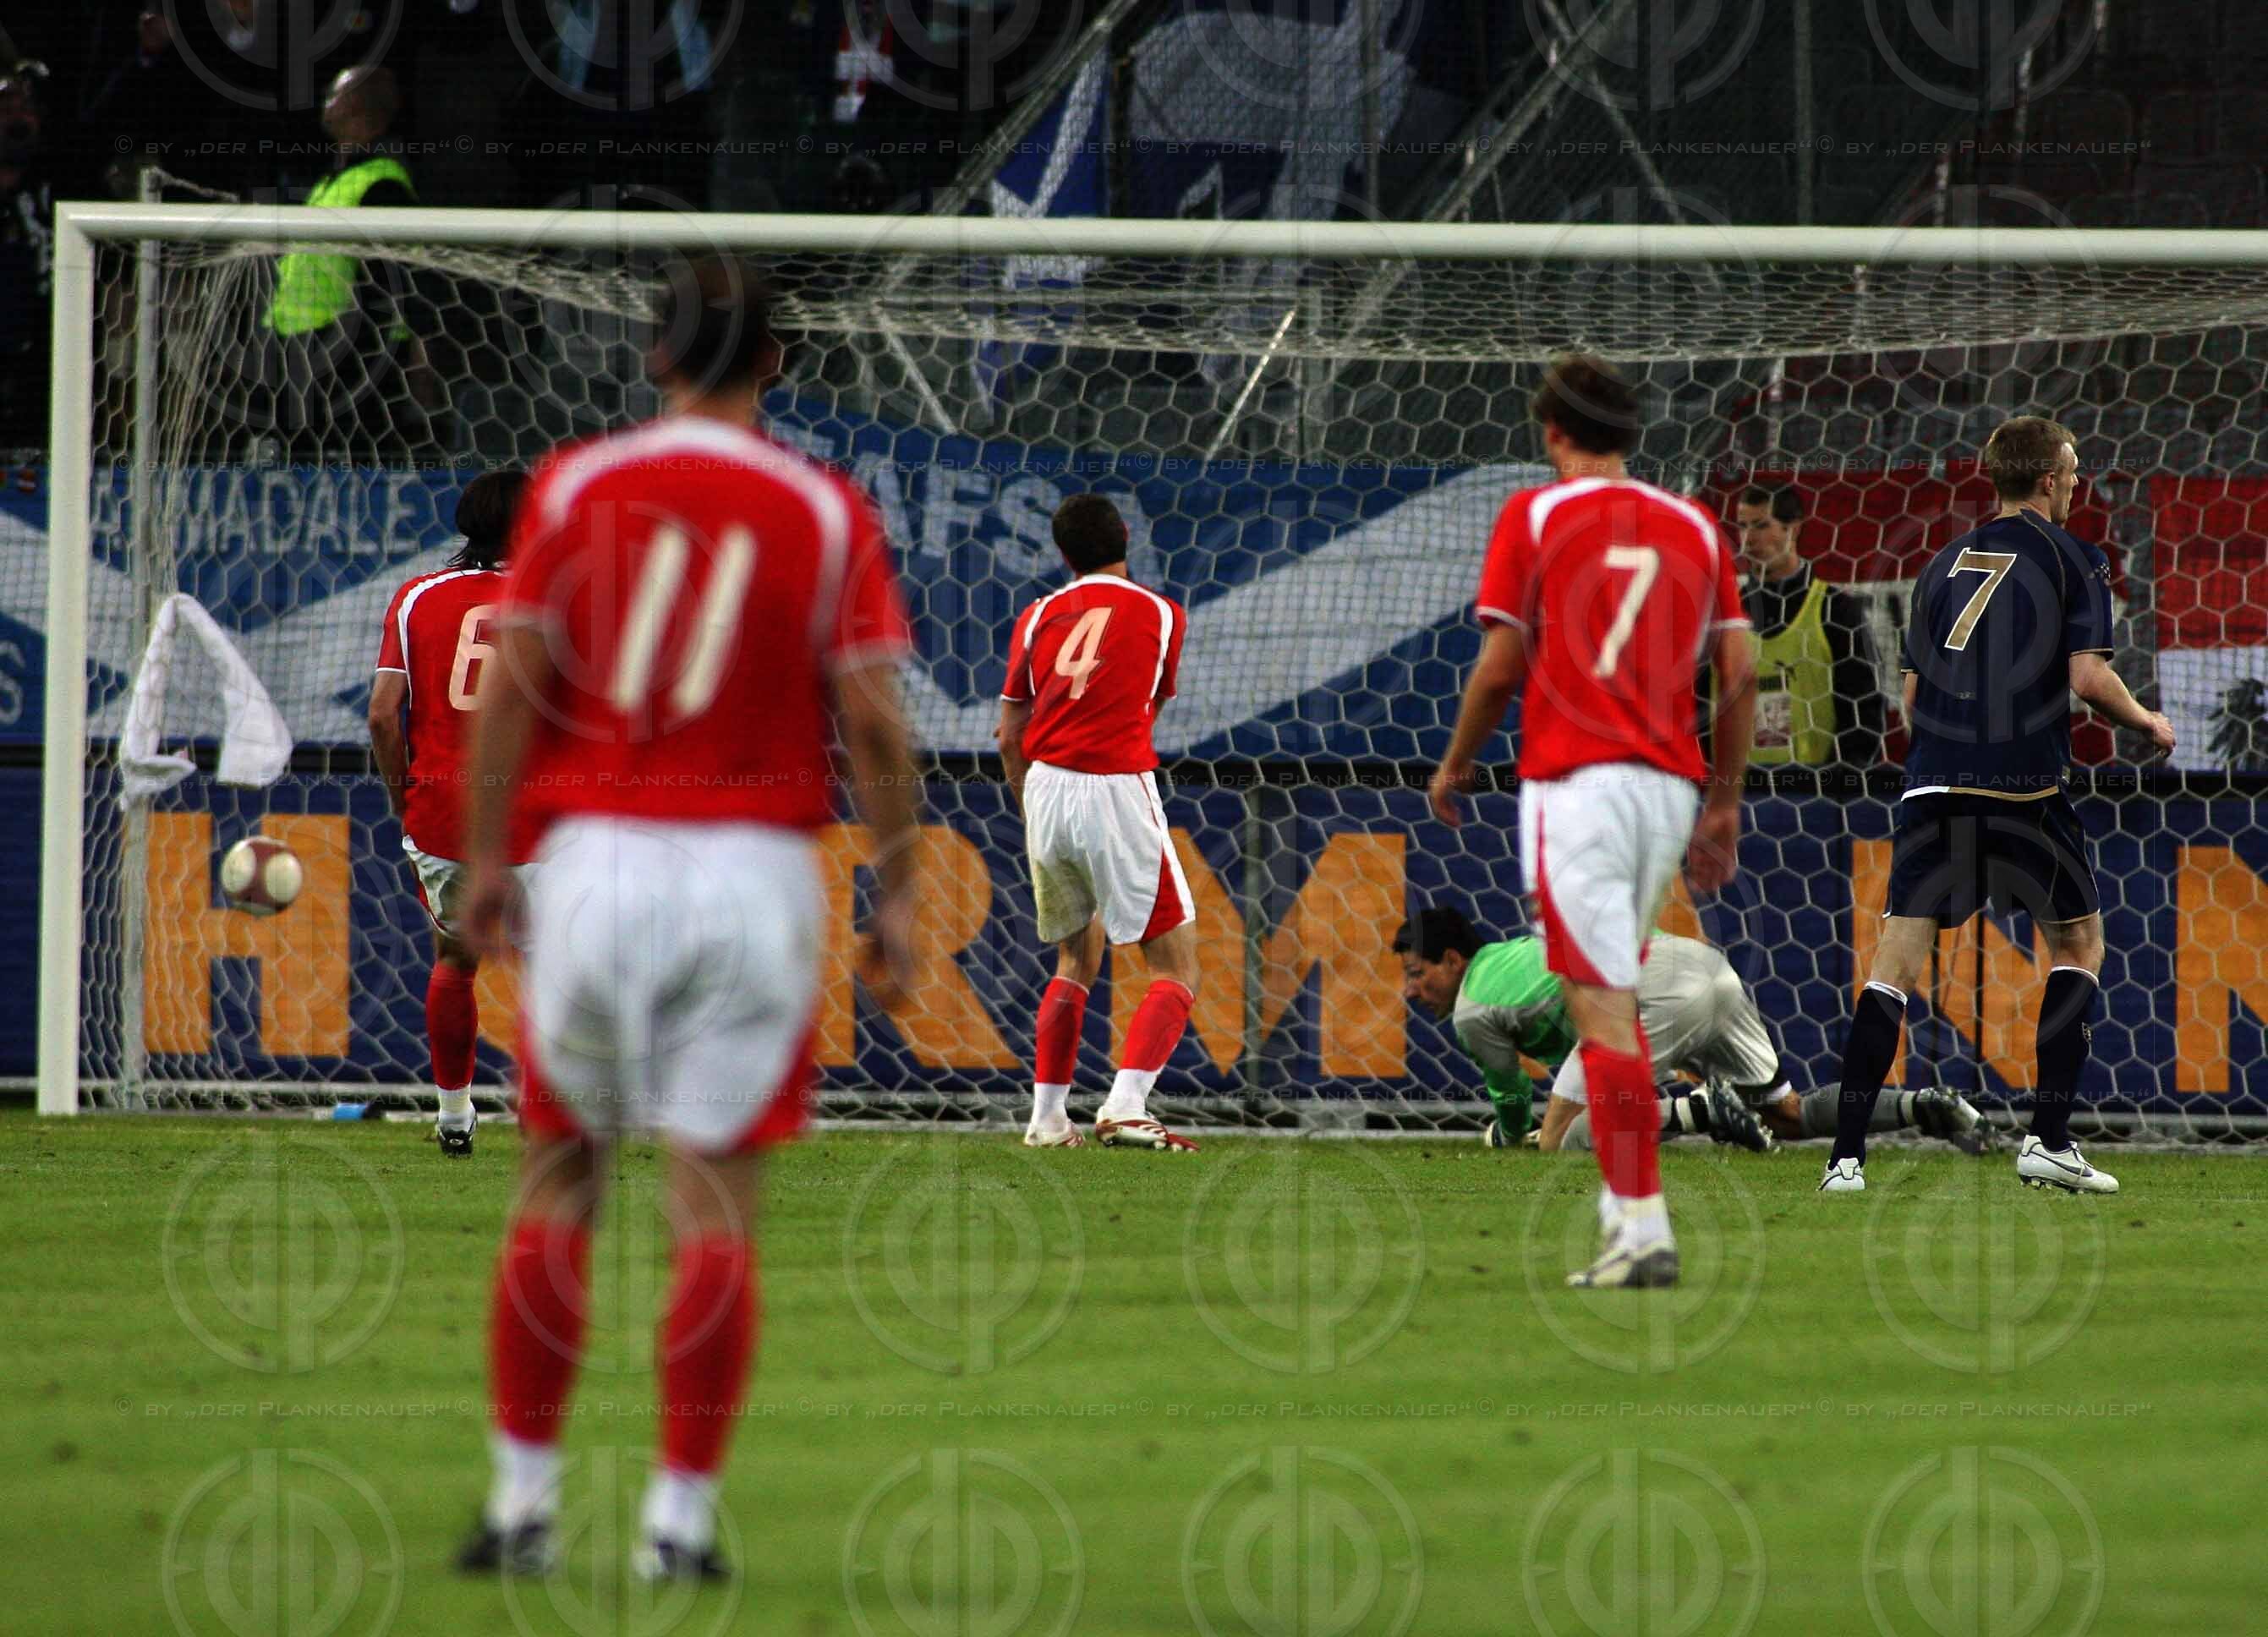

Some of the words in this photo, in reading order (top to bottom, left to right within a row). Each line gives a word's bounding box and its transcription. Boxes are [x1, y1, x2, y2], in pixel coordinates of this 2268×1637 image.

[607, 520, 759, 714] 11
[1592, 545, 1660, 678] 7
[1943, 545, 2018, 651] 7
[449, 604, 501, 711] 6
[1055, 606, 1114, 700] 4
